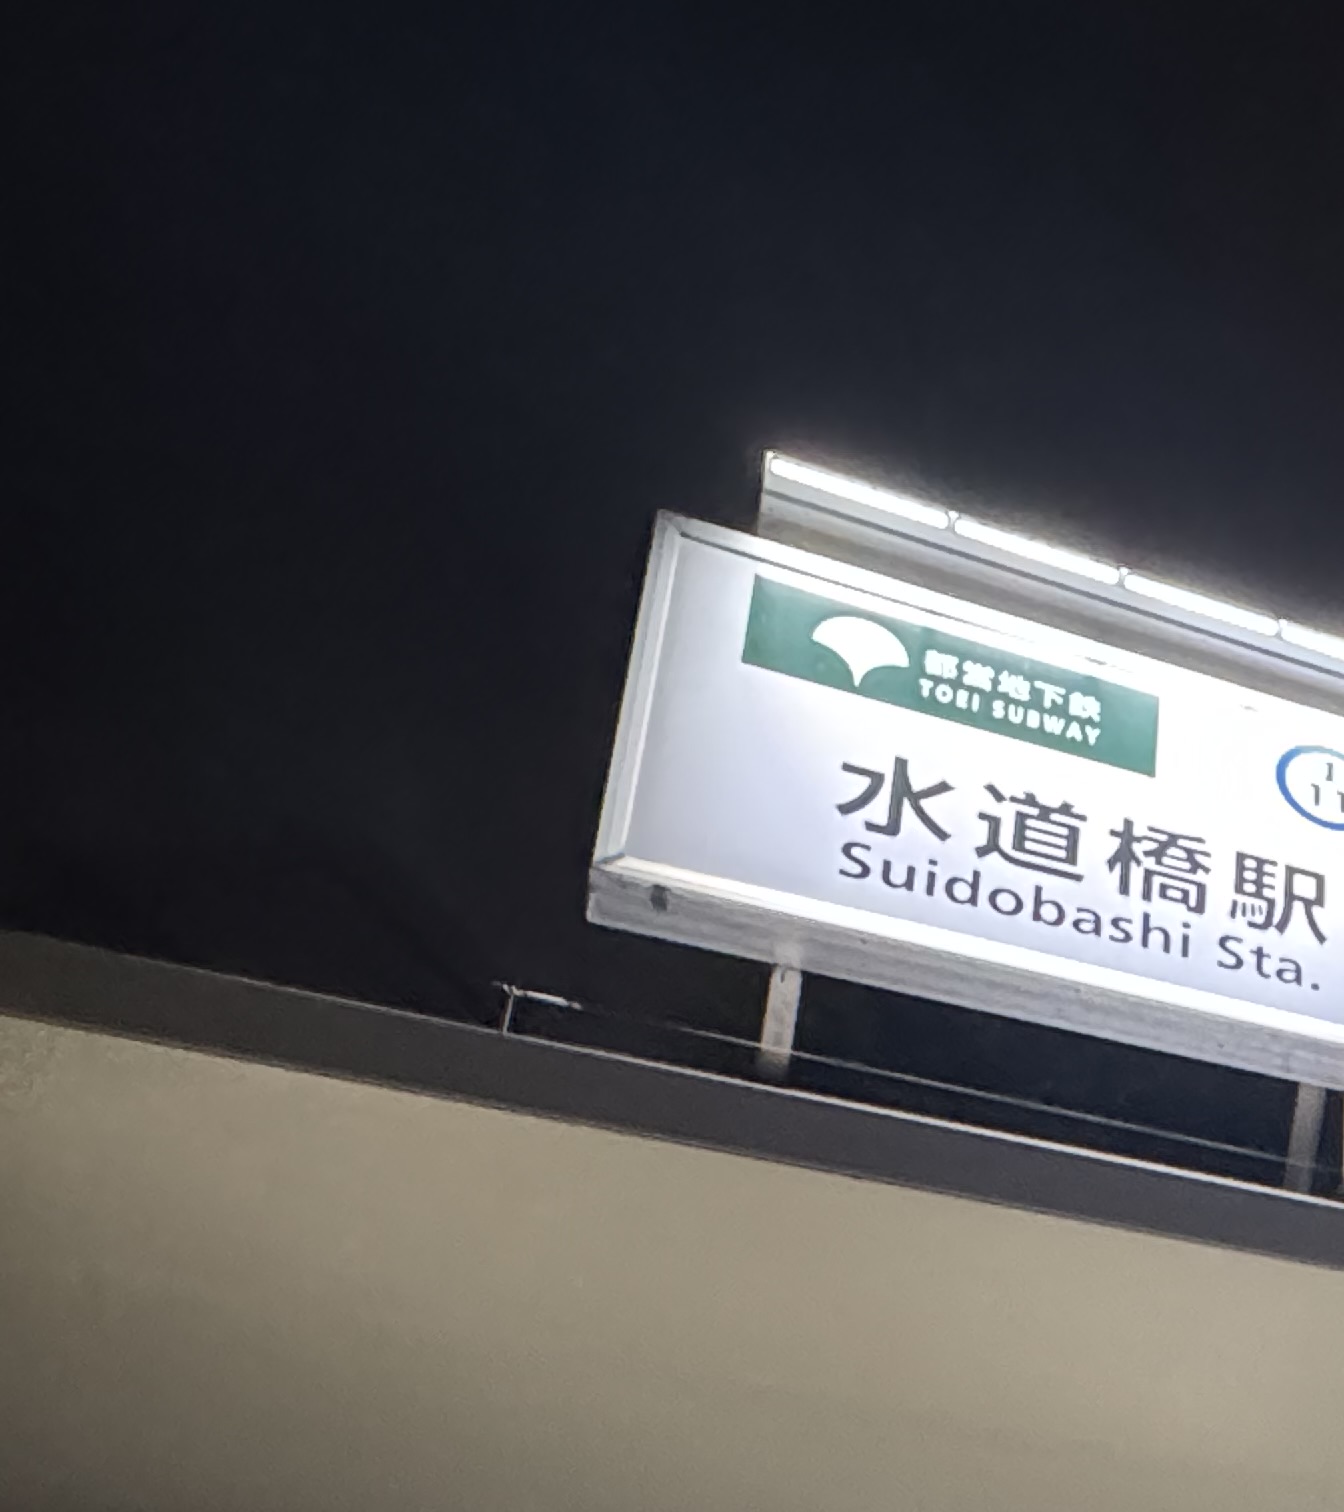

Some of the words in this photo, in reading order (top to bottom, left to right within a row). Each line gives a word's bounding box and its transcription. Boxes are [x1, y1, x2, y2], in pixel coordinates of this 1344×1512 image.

[918, 678, 980, 713] TOEI
[992, 699, 1101, 746] SUBWAY
[836, 755, 1327, 945] 水道橋駅
[838, 841, 1193, 959] Suidobashi
[1216, 934, 1321, 991] Sta.
